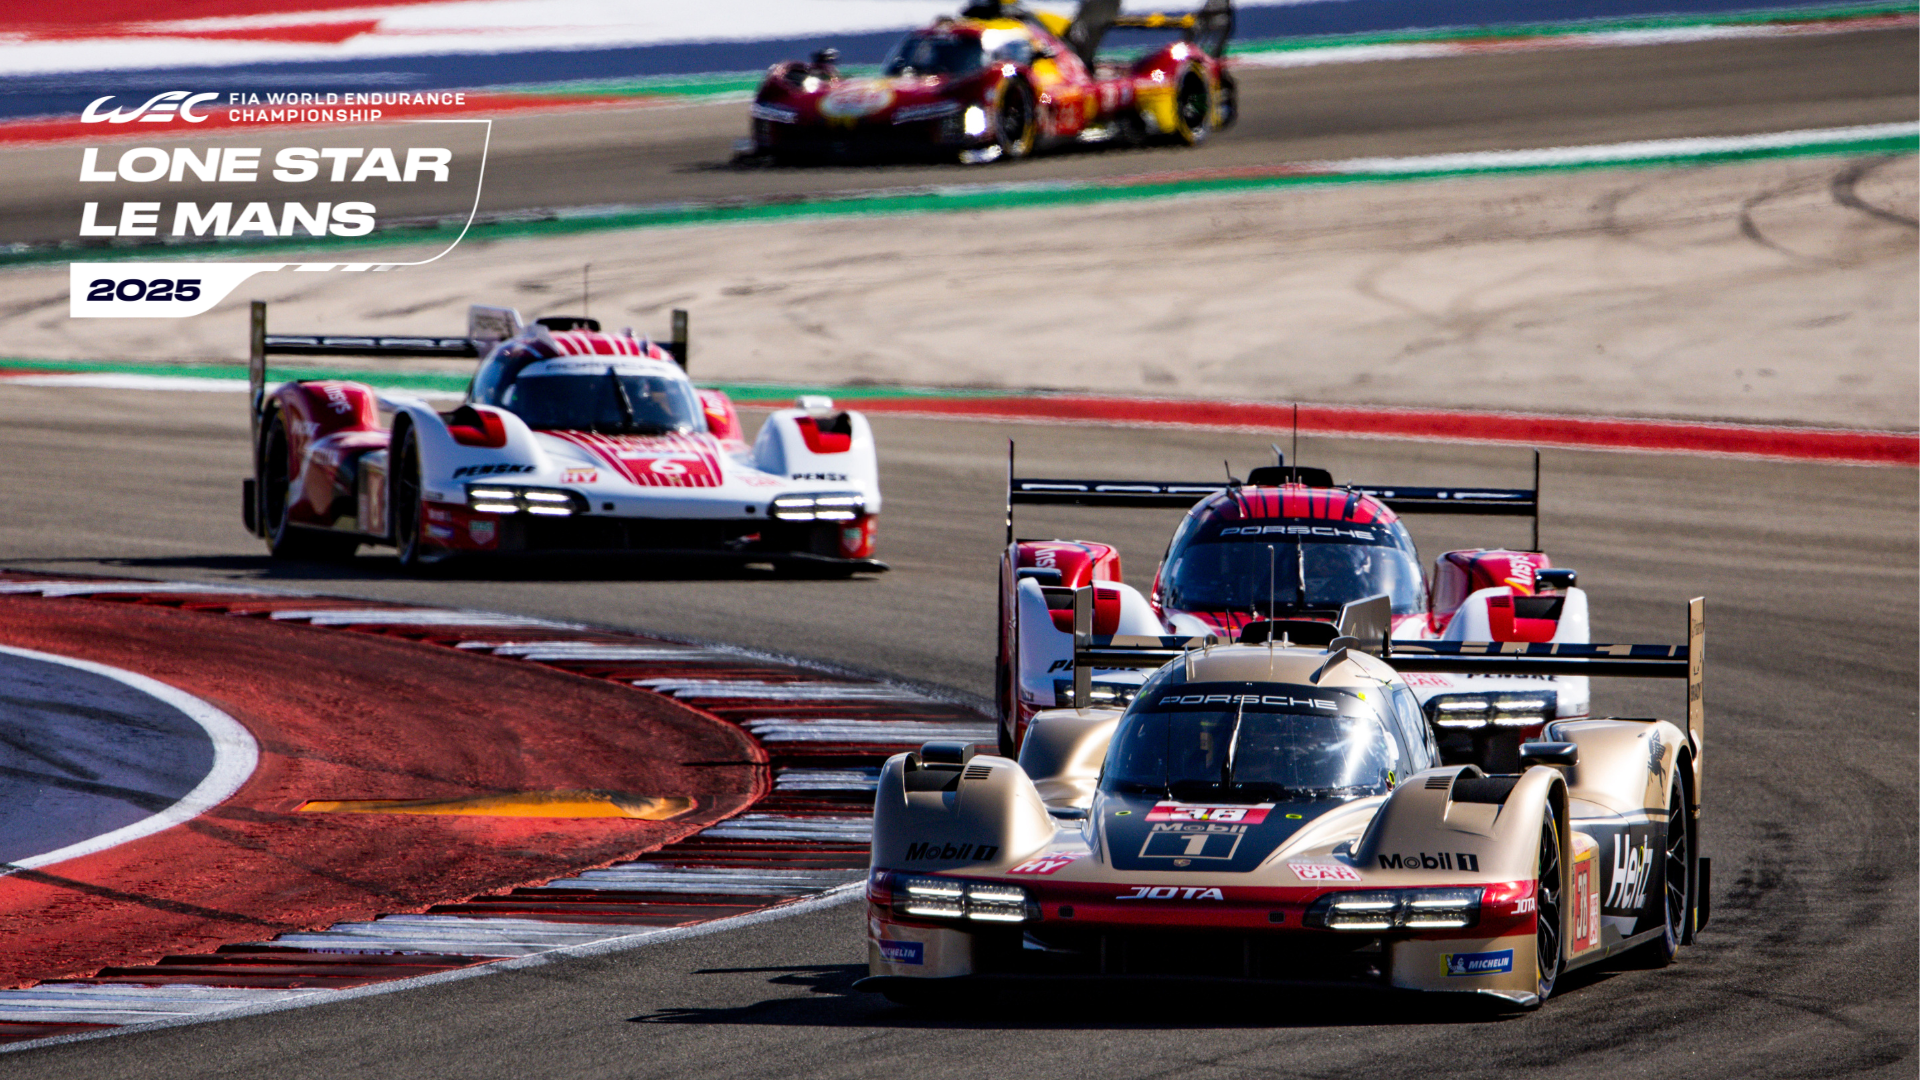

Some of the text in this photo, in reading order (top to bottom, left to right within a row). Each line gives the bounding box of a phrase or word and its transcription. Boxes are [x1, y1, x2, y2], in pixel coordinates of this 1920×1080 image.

[452, 463, 537, 479] PENSKE
[649, 458, 688, 475] 6
[1219, 525, 1375, 541] PORSCHE
[1158, 693, 1338, 711] PORSCHE
[1170, 808, 1248, 822] 38
[1151, 823, 1249, 834] Mobil
[905, 843, 973, 861] Mobil
[1181, 834, 1209, 856] 1
[1012, 860, 1069, 873] HY
[1378, 852, 1453, 870] Mobil
[1299, 870, 1356, 880] CAR
[1604, 833, 1654, 910] Hertz
[1116, 886, 1224, 900] JOTA
[1510, 897, 1536, 915] JOTA
[1468, 957, 1510, 970] MICHELIN
